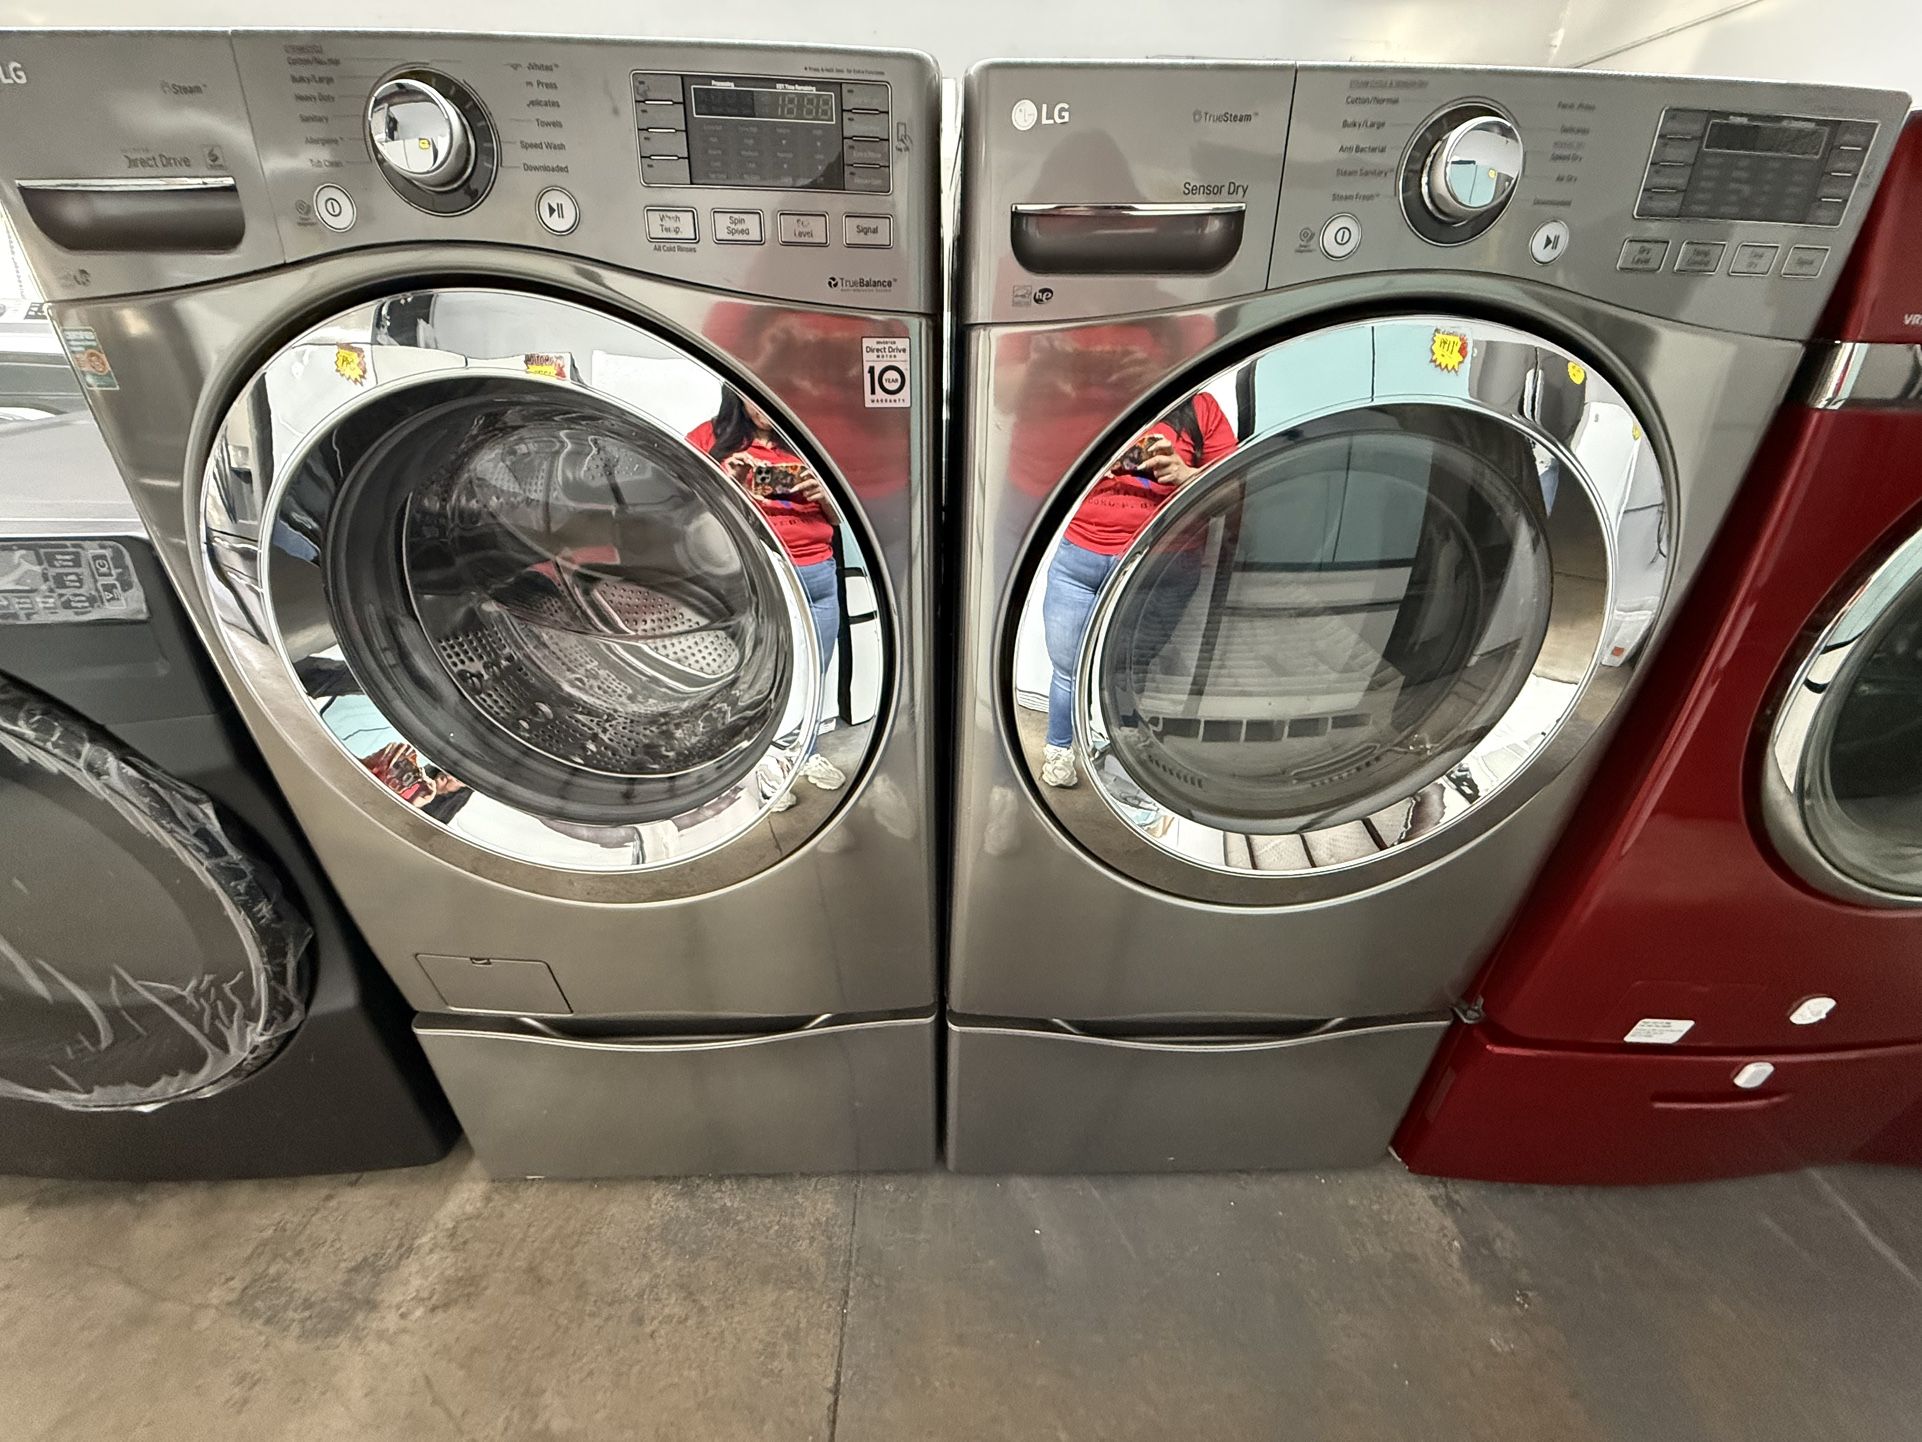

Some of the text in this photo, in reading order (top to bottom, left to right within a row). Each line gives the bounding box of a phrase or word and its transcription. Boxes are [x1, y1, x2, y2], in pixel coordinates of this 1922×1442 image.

[0, 61, 27, 84] LG
[536, 80, 559, 90] Press
[527, 99, 560, 108] elicates
[1041, 102, 1070, 125] LG
[1203, 112, 1252, 123] TrueSteam
[535, 118, 563, 128] Towels
[520, 140, 566, 151] Speed Wash
[523, 163, 569, 173] Downloaded
[1183, 181, 1249, 198] Sensor Dry
[728, 215, 746, 226] Spin
[856, 224, 879, 236] Signal
[840, 277, 893, 288] TrueBalance
[865, 346, 907, 354] Direct Drive
[868, 365, 906, 395] 10
